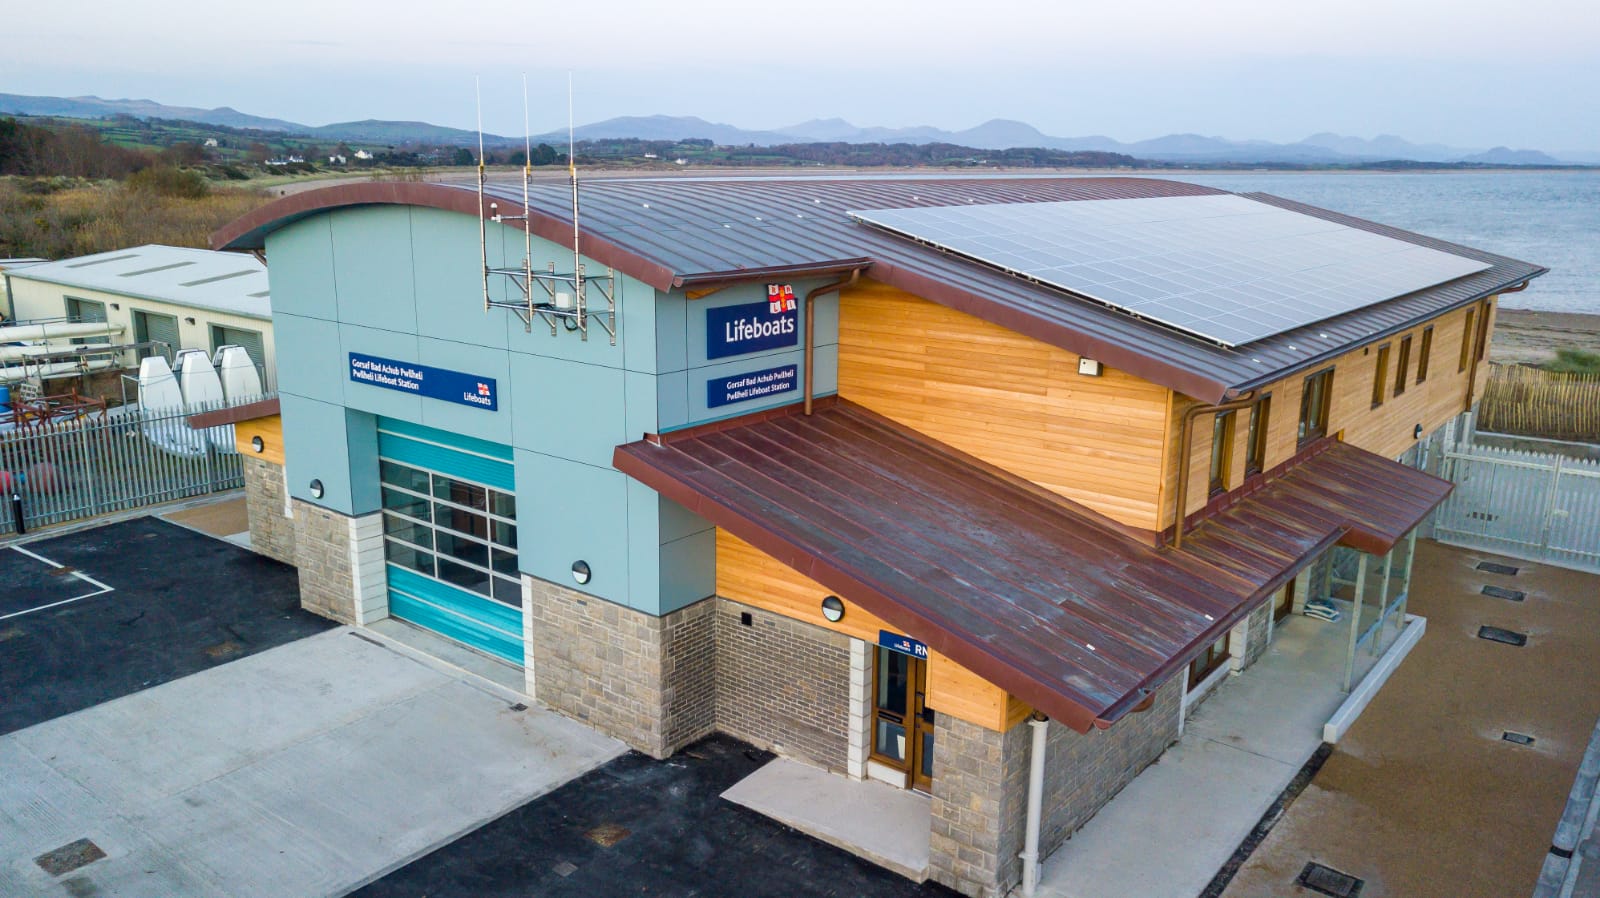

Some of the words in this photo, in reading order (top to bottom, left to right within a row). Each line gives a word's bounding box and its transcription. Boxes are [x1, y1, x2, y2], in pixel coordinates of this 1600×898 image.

[726, 315, 794, 343] Lifeboats
[352, 359, 370, 369] Gorsaf
[370, 362, 381, 371] Bad
[382, 364, 399, 375] Achub
[400, 367, 423, 380] Pwllheli
[352, 369, 374, 381] Pwllheli
[374, 374, 397, 386] Lifeboat
[398, 378, 419, 390] Station
[726, 379, 746, 390] Gorsaf
[746, 376, 756, 386] Bad
[757, 374, 773, 384] Achub
[773, 369, 794, 380] Pwllheli
[463, 391, 492, 406] Lifeboats
[726, 389, 748, 401] Pwllheli
[749, 385, 770, 396] Lifeboat
[771, 382, 790, 392] Station
